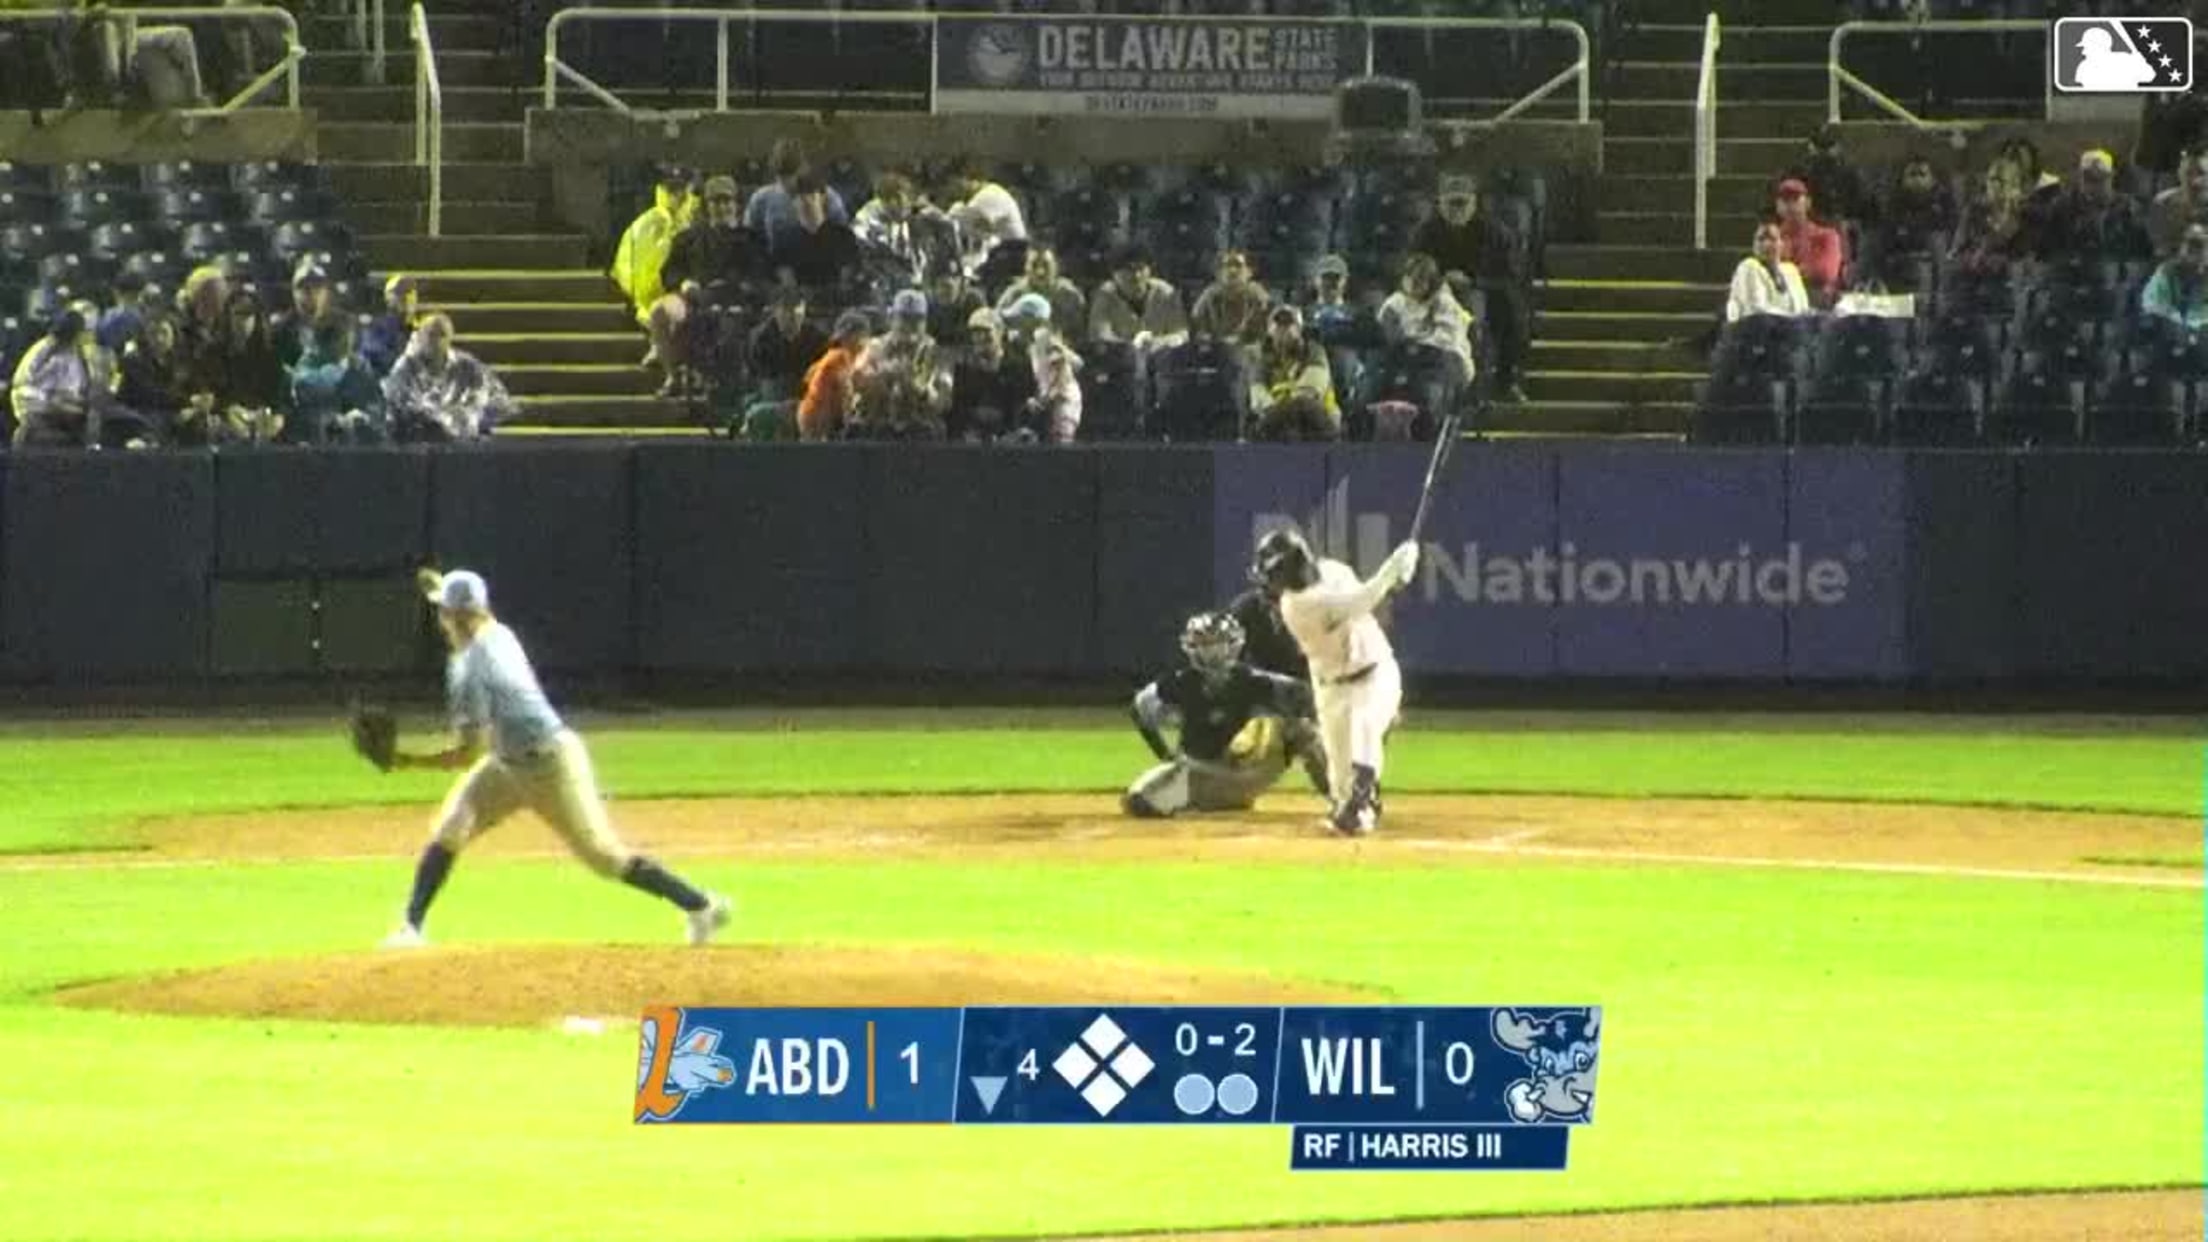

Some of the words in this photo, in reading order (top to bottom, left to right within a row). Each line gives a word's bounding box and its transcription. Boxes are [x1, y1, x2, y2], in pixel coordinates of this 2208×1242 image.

[1039, 25, 1270, 71] DELAWARE
[1274, 28, 1336, 48] STATE
[1275, 51, 1337, 71] PARKS
[1423, 541, 1849, 603] Nationwide
